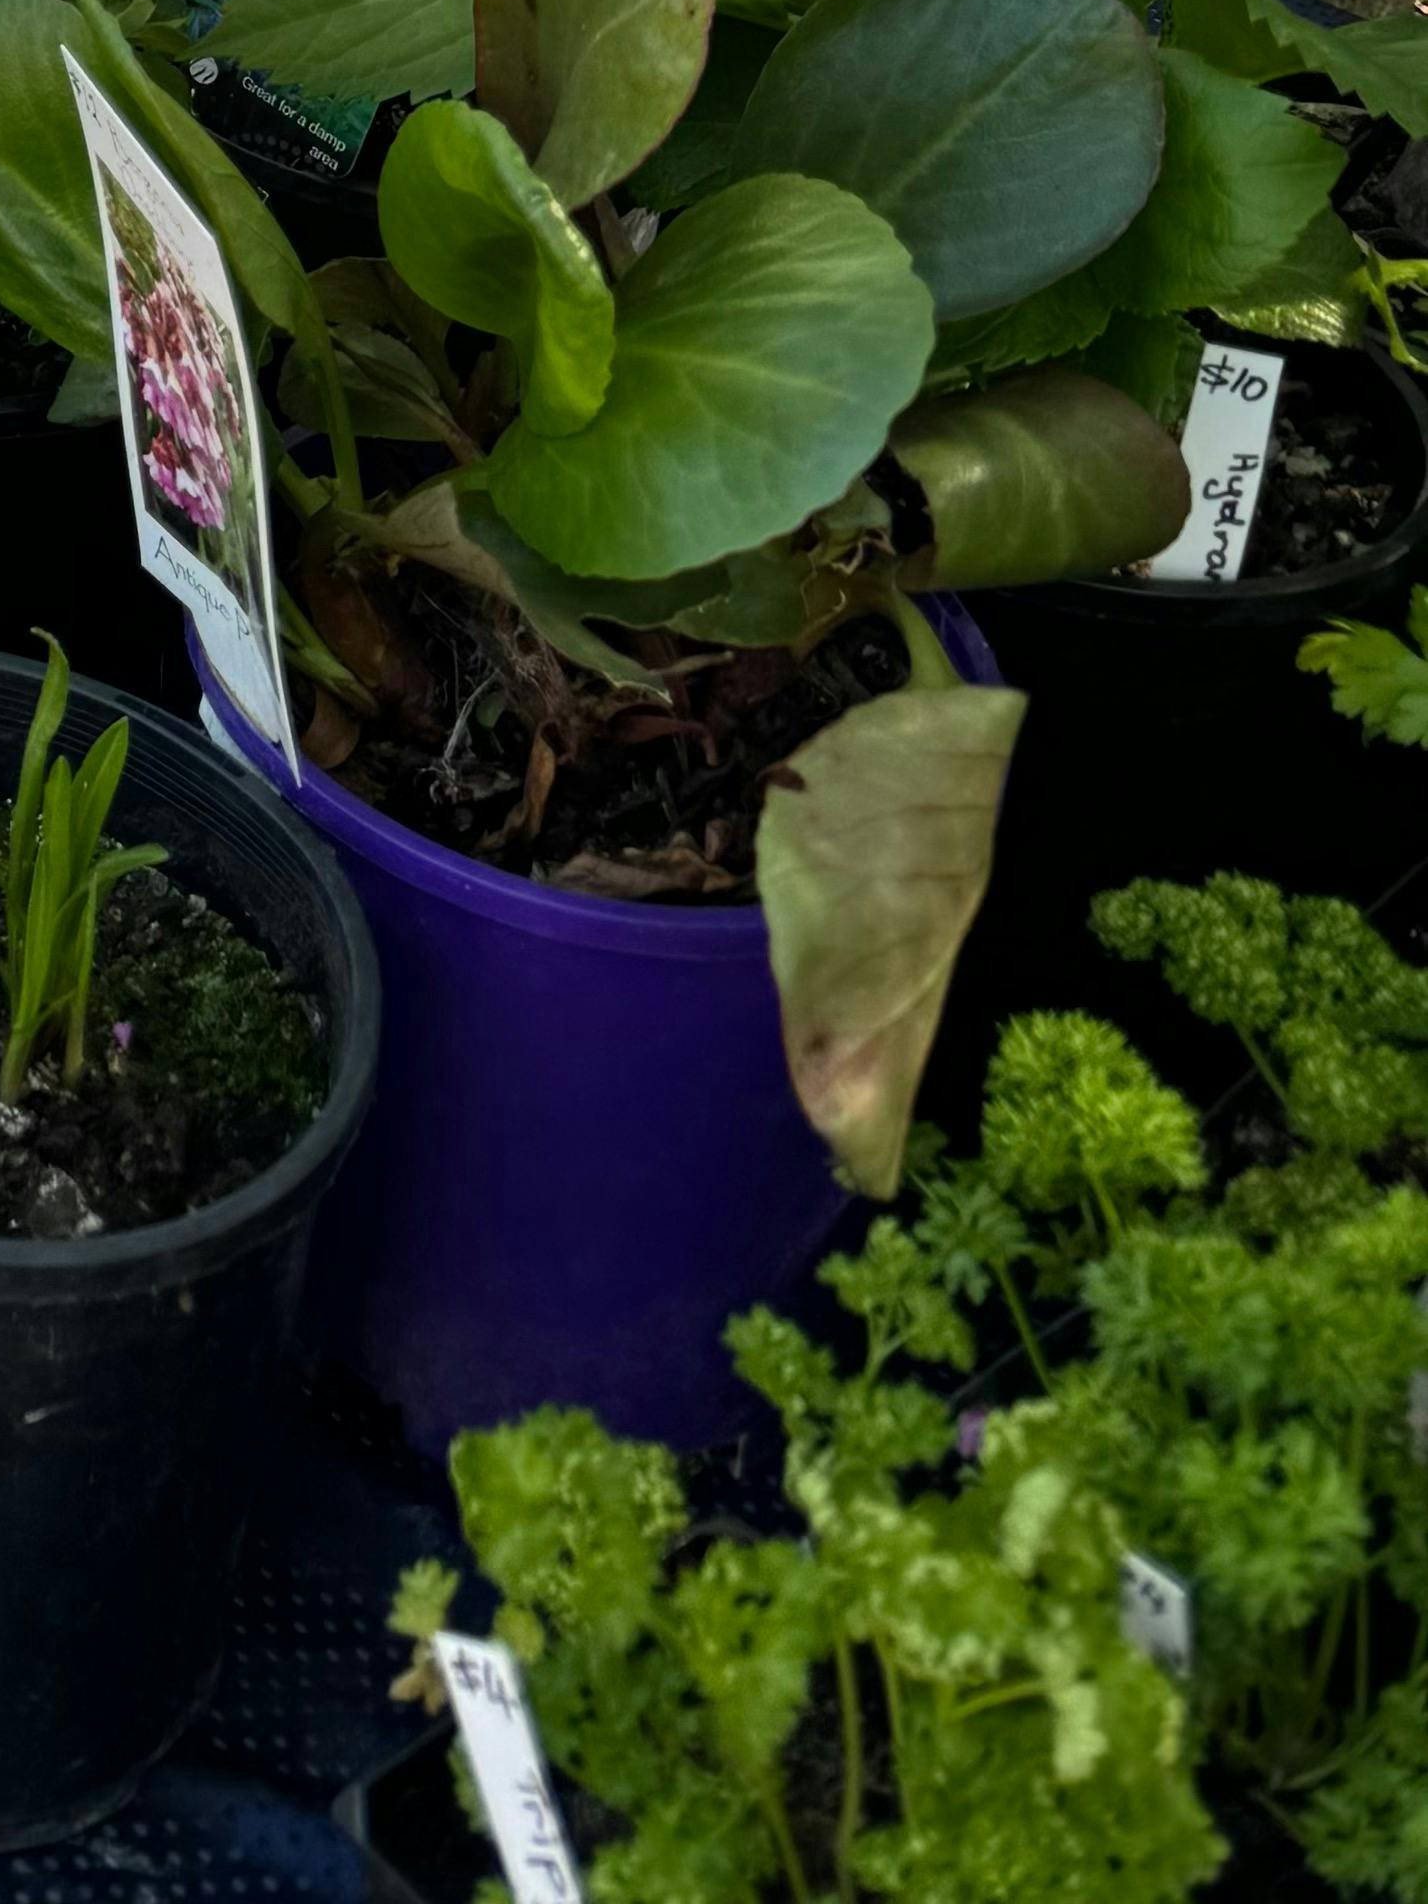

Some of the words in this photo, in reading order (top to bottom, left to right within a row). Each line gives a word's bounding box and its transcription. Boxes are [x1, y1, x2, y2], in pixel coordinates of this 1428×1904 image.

[241, 74, 280, 109] Great
[276, 96, 298, 121] for
[296, 115, 308, 129] a
[307, 119, 347, 155] damp
[308, 143, 341, 173] area
[1200, 354, 1270, 403] $10
[153, 535, 234, 622] Antique
[450, 1645, 514, 1722] $4
